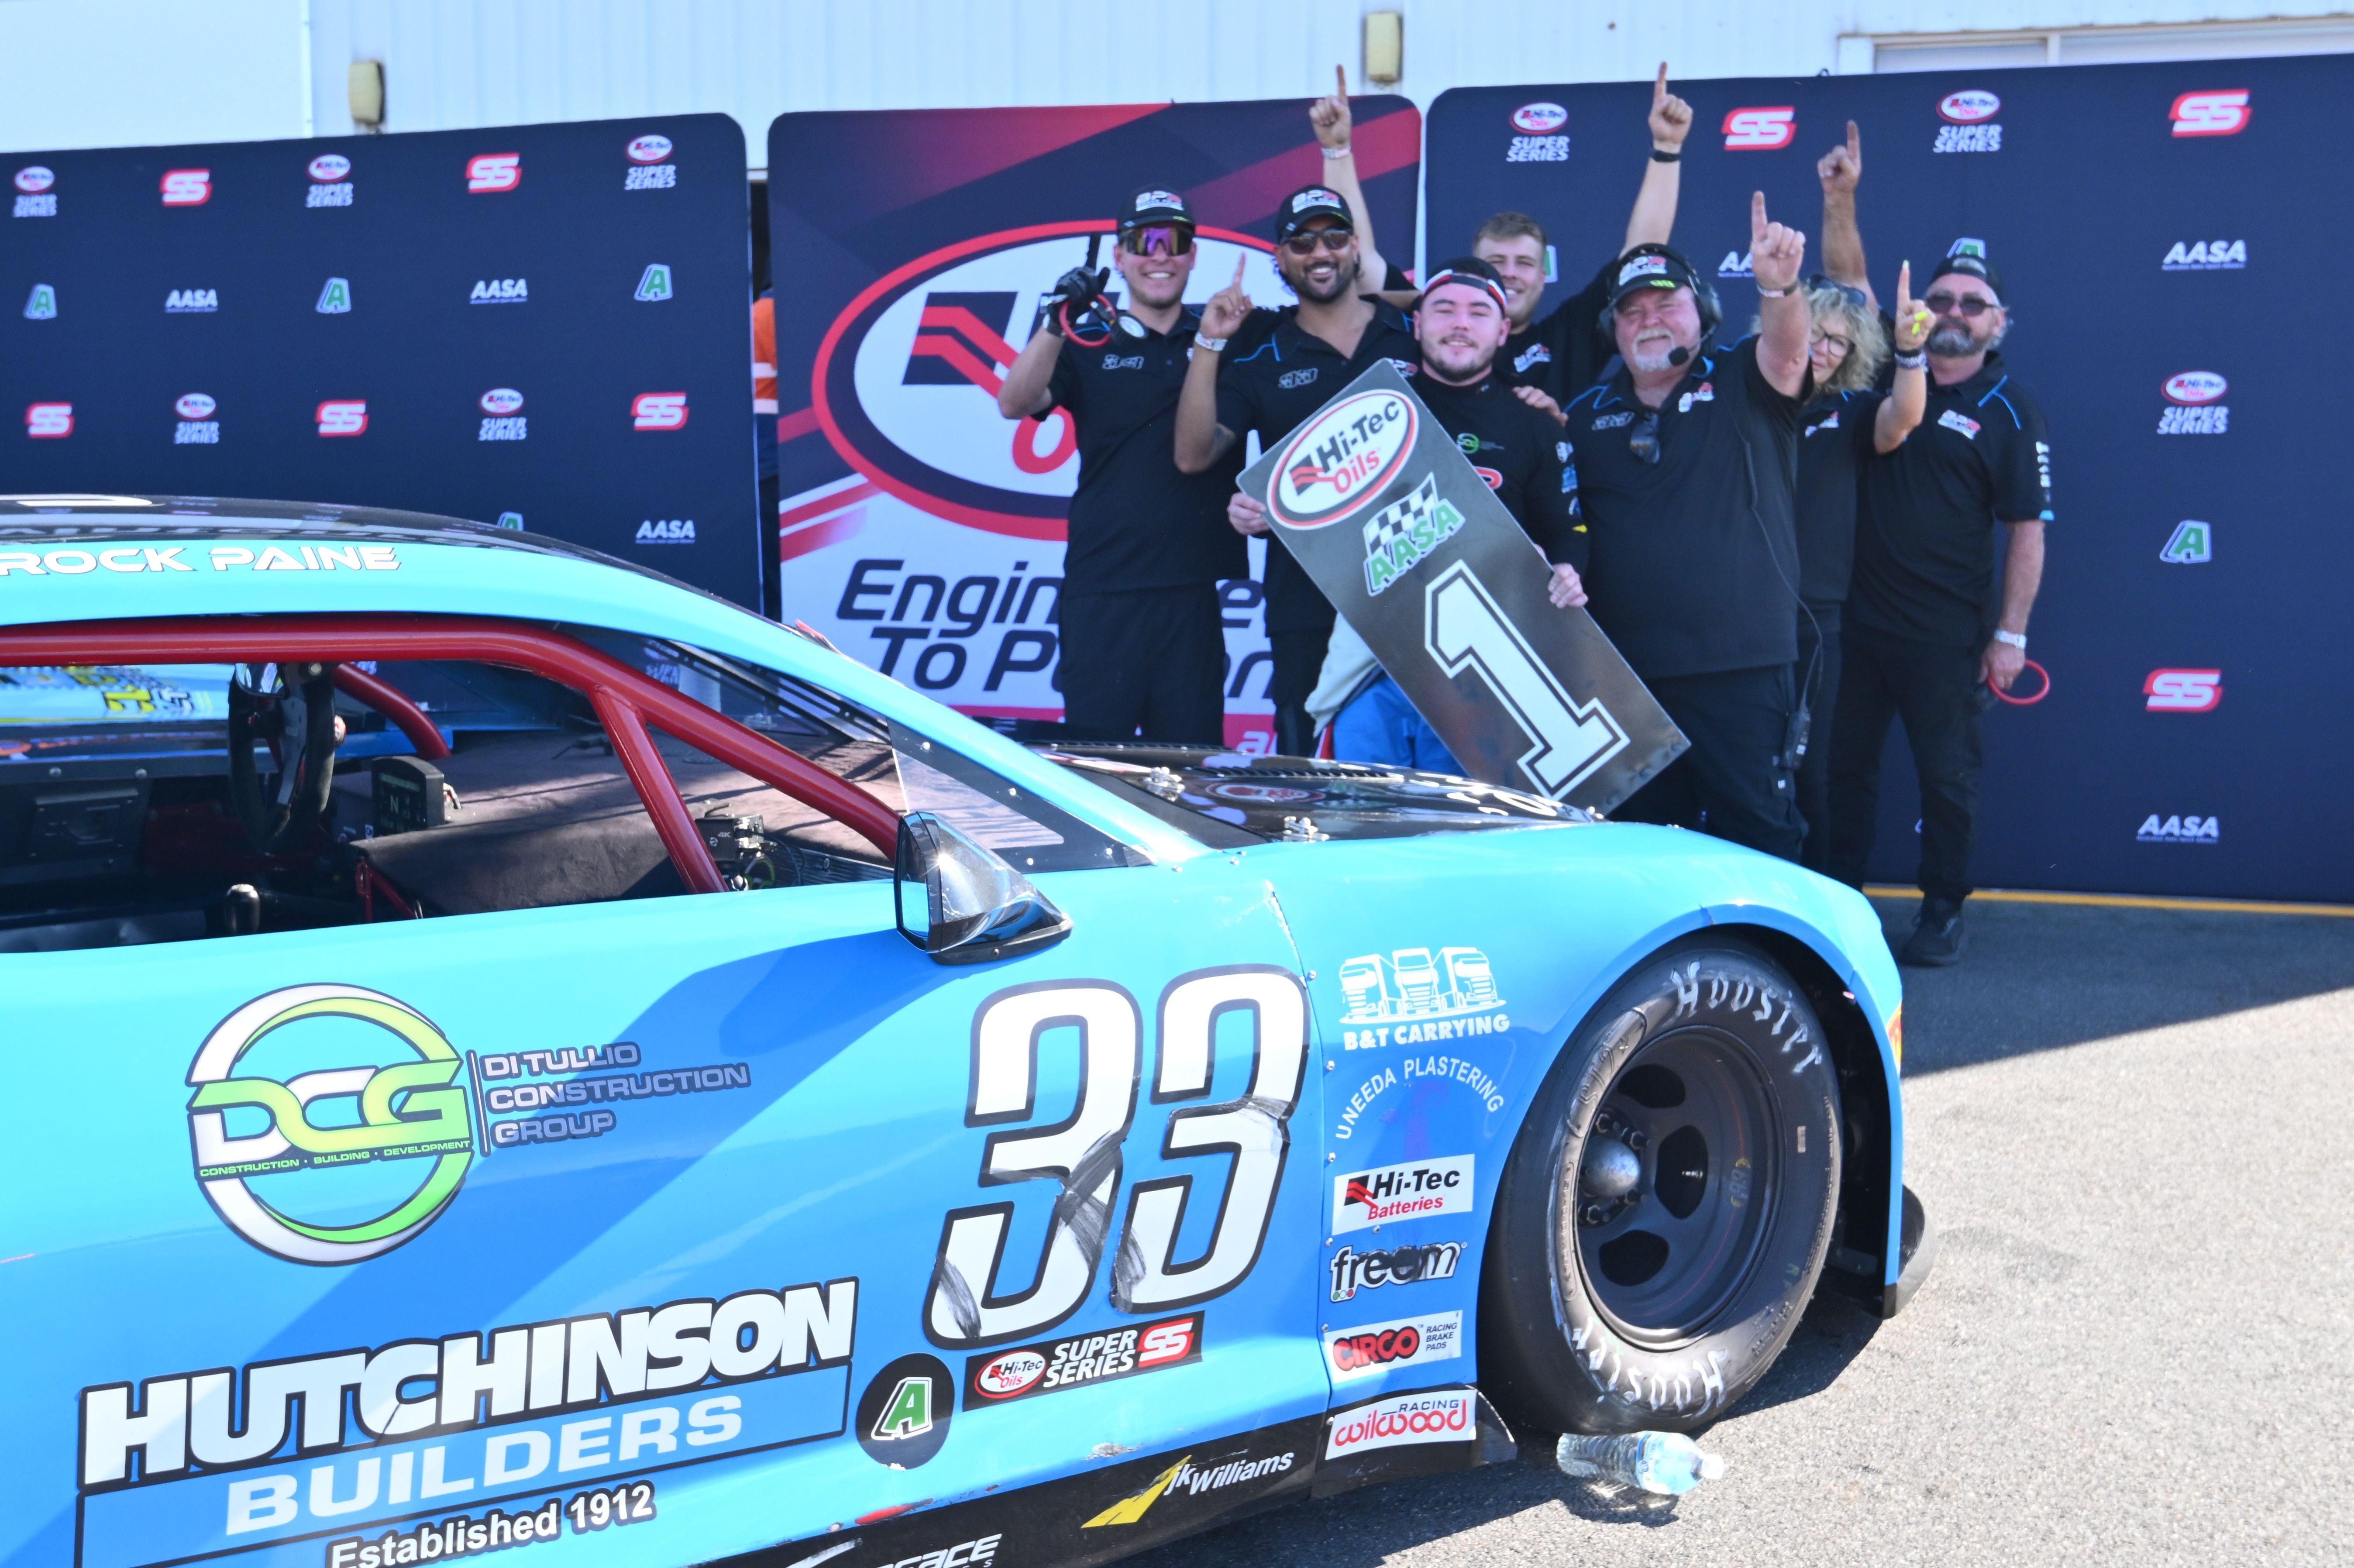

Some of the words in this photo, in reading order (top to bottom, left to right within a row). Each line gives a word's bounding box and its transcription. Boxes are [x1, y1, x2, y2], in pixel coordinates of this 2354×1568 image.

[1512, 136, 1570, 149] SUPER
[1934, 138, 2000, 153] SERIES
[1940, 125, 2002, 139] SUPER
[1507, 148, 1569, 162] SERIES
[625, 177, 675, 189] SERIES
[628, 165, 675, 177] SUPER
[2163, 240, 2246, 264] AASA
[166, 289, 217, 307] AASA
[470, 279, 527, 298] AASA
[2158, 420, 2228, 434] SERIES
[2162, 406, 2228, 421] SUPER
[1315, 400, 1400, 474] Hi-Tec
[1334, 450, 1380, 494] Oils
[636, 520, 695, 539] AASA
[208, 547, 402, 571] PAINE
[1366, 500, 1464, 594] AASA
[871, 627, 967, 690] To
[1425, 559, 1631, 801] 1
[2137, 815, 2219, 837] AASA
[1343, 1028, 1389, 1051] B&T
[1394, 1014, 1510, 1044] CARRYING
[485, 1055, 518, 1076] DI
[523, 1044, 638, 1073] TULLIO
[489, 1066, 748, 1110] CONSTRUCTION
[1335, 1067, 1397, 1139] UNEEDA
[1404, 1056, 1504, 1113] PLASTERING
[186, 1060, 471, 1168] DCG
[495, 1112, 613, 1144] GROUP
[200, 1158, 300, 1177] CONSTRUCTION
[313, 1151, 371, 1165] BUILDING
[383, 1140, 471, 1156] DEVELOPMENT
[925, 966, 1308, 1346] 33
[1372, 1168, 1460, 1200] Hi-Tec
[1367, 1195, 1444, 1221] Batteries
[1426, 1322, 1458, 1334] RACING
[1426, 1331, 1454, 1342] BRAKE
[1051, 1330, 1138, 1365] SUPER
[1332, 1326, 1420, 1372] CIRCO
[1426, 1341, 1447, 1351] PADS
[1003, 1358, 1043, 1375] Hi-Tec
[1043, 1349, 1136, 1388] SERIES
[83, 1280, 858, 1485] HUTCHINSON
[1000, 1375, 1023, 1388] Oils
[1398, 1399, 1460, 1413] RACING
[1334, 1399, 1467, 1446] wilwood
[226, 1393, 743, 1536] BUILDERS
[330, 1503, 558, 1568] Established
[570, 1484, 653, 1529] 1912
